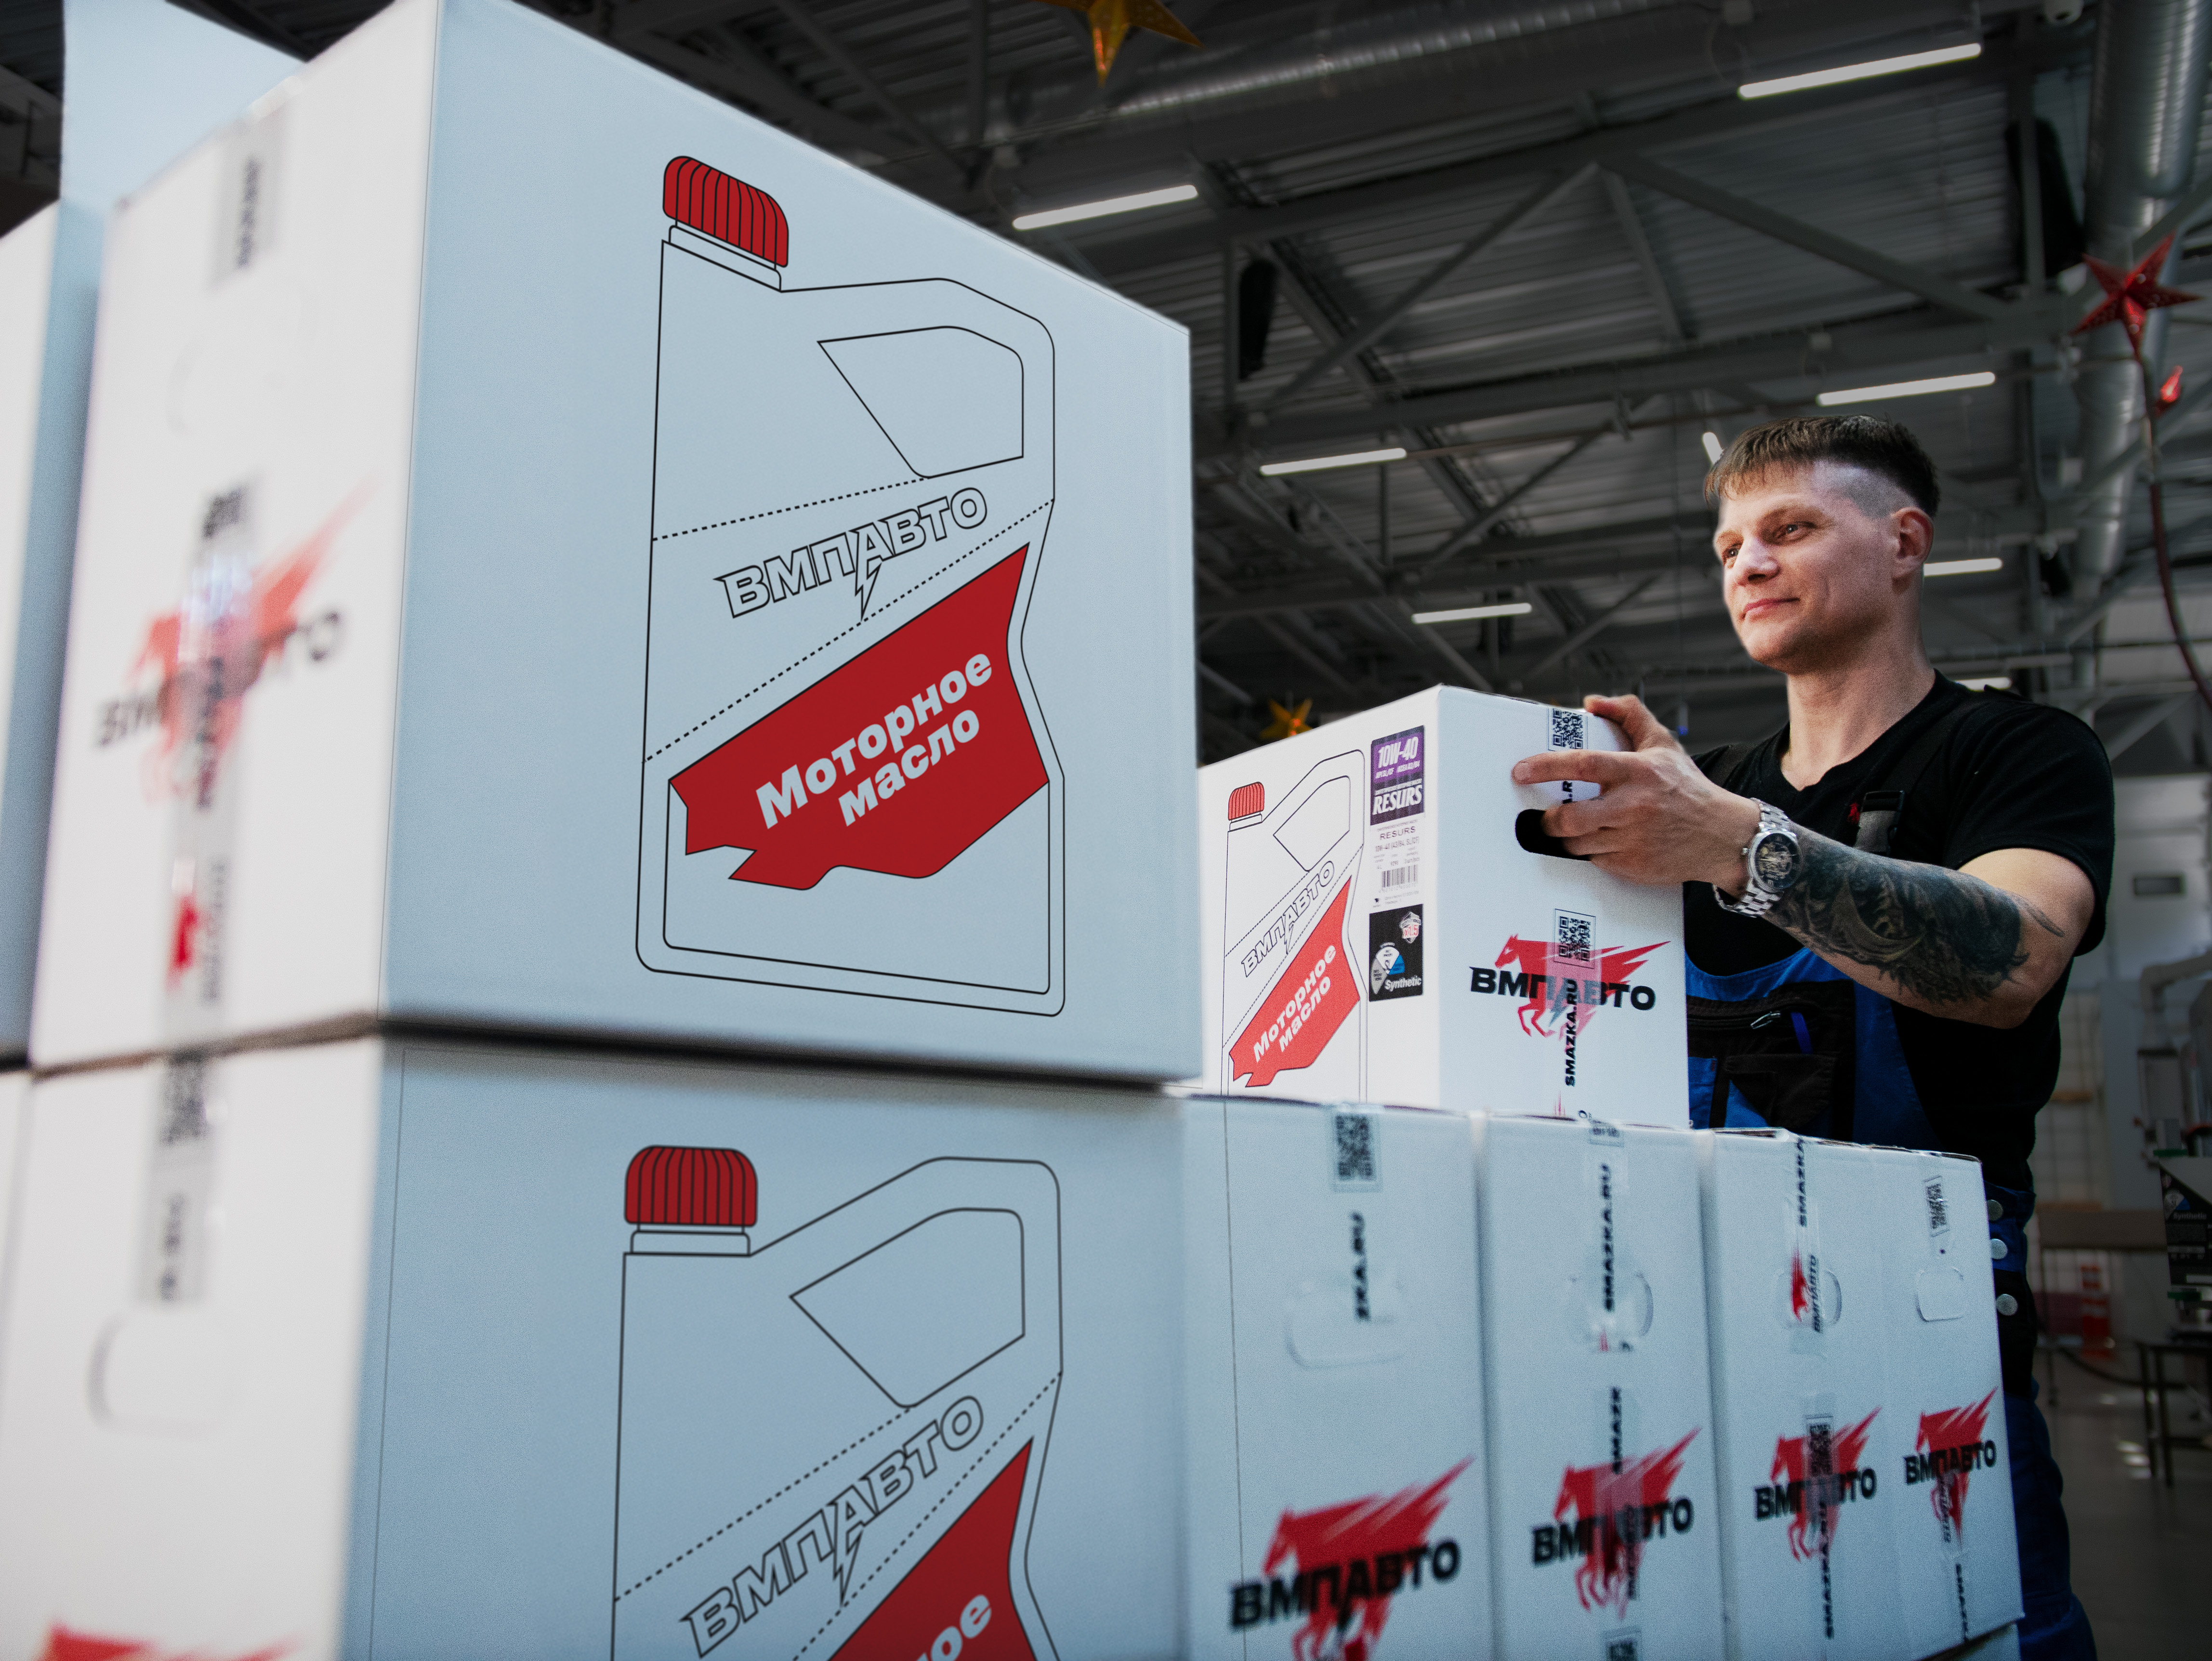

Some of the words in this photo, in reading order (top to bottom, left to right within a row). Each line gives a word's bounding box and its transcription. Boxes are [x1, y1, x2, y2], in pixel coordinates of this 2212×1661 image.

[713, 488, 988, 621] ВМПАВТО
[755, 653, 992, 830] Моторное
[838, 709, 980, 827] масло
[1378, 736, 1419, 768] 10W-40
[1372, 784, 1423, 816] RESURS
[1380, 826, 1416, 840] RESURS
[1241, 860, 1335, 977] ВМПАВТО
[1253, 945, 1336, 1063] Моторное
[1278, 976, 1331, 1053] масло
[1384, 975, 1422, 992] Synthetic
[1469, 966, 1657, 1027] ВМПАВТО
[1564, 978, 1578, 1087] SMAZKA.RU
[1903, 1439, 1998, 1486] ВМПАВТО
[679, 1395, 984, 1659] ВМПАВТО
[1531, 1497, 1695, 1568] ВМПТО
[1229, 1537, 1462, 1632] ВМПАВТО
